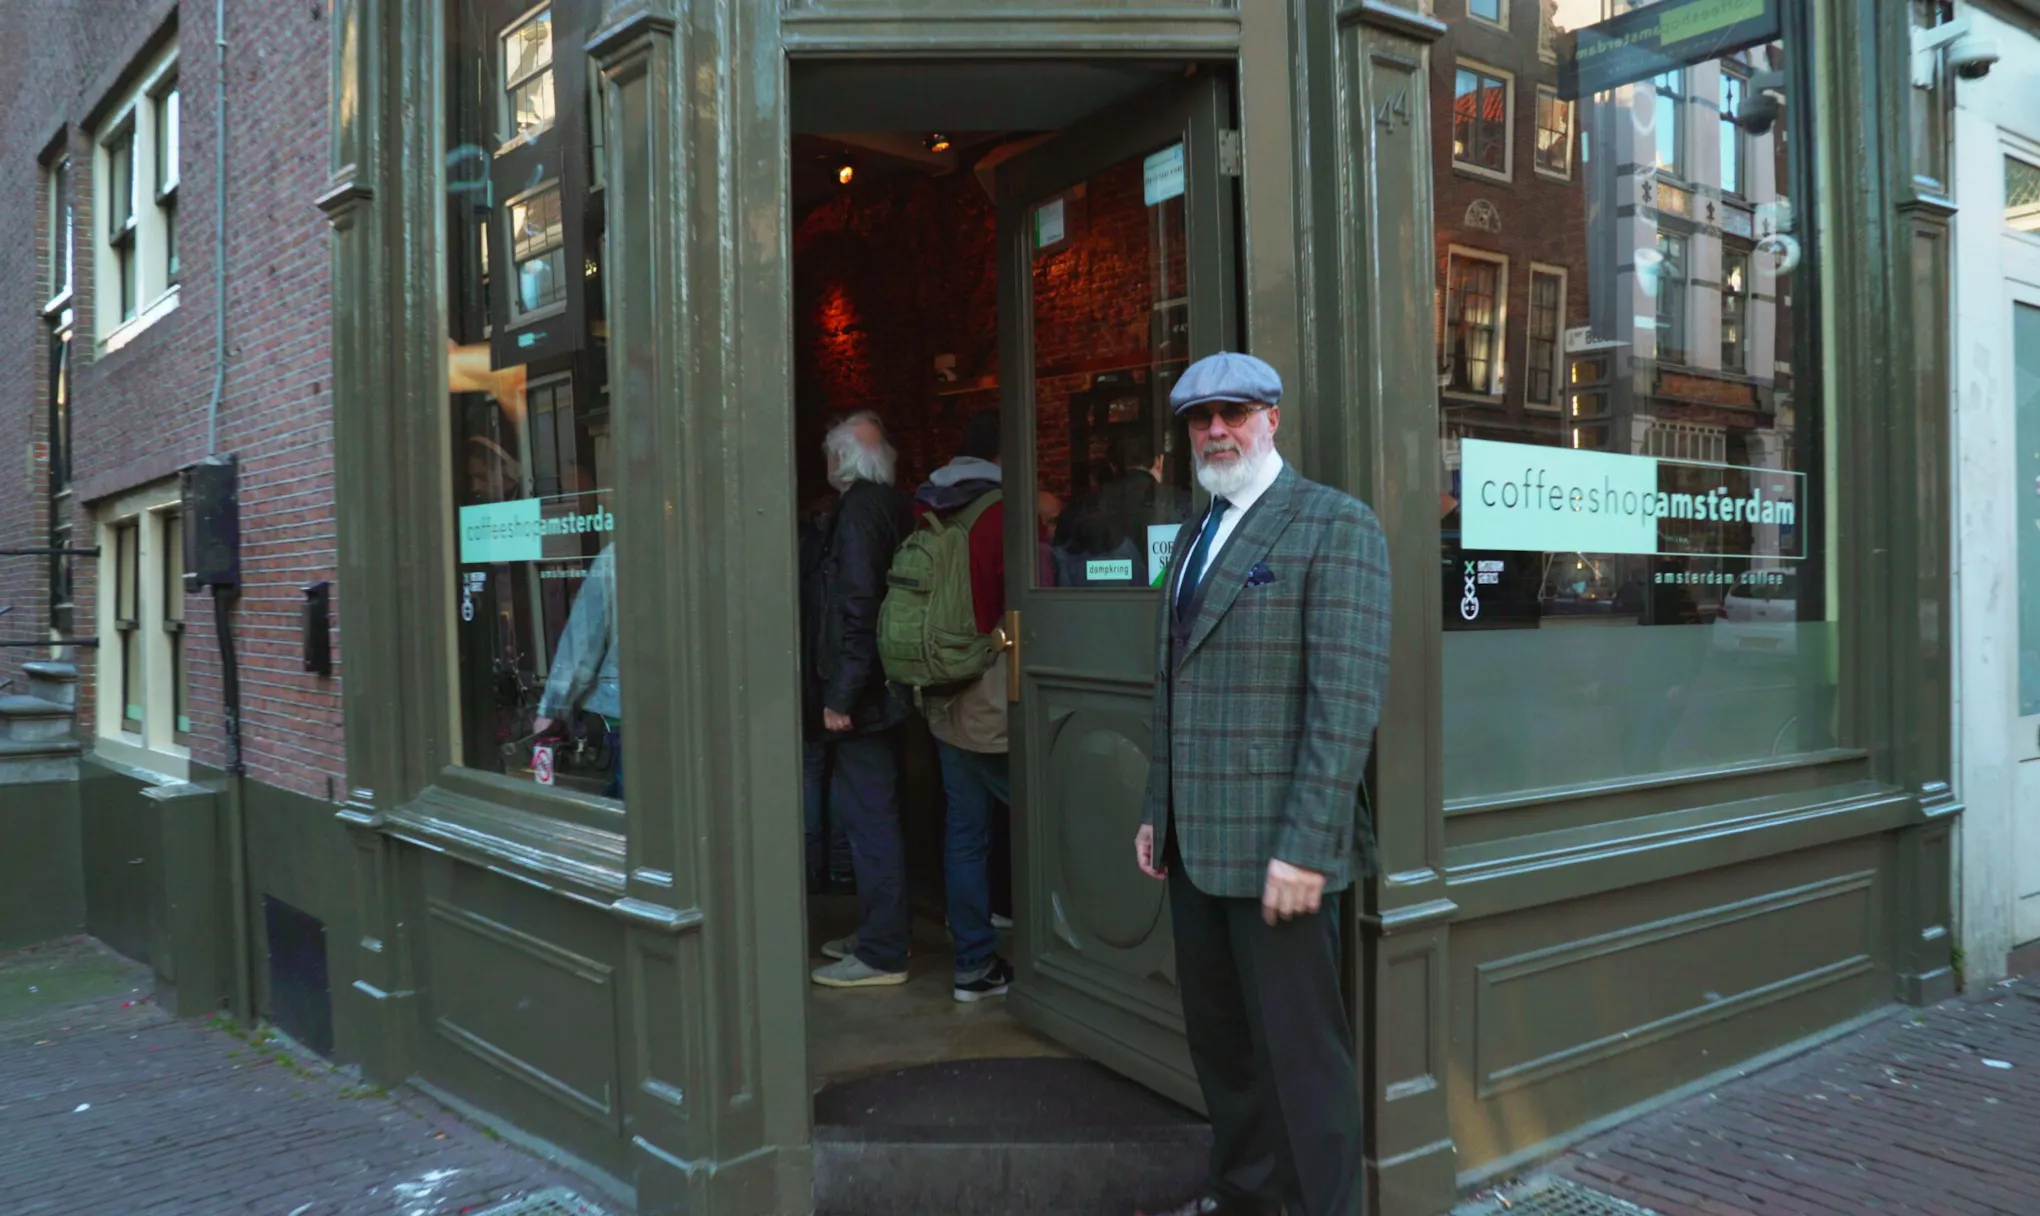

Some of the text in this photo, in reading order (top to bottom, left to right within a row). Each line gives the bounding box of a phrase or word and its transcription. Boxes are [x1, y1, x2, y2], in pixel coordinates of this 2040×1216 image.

[1376, 86, 1410, 135] 44
[1656, 488, 1794, 525] amsterdam
[1089, 564, 1129, 576] dampkring
[1654, 570, 1734, 585] amsterdam
